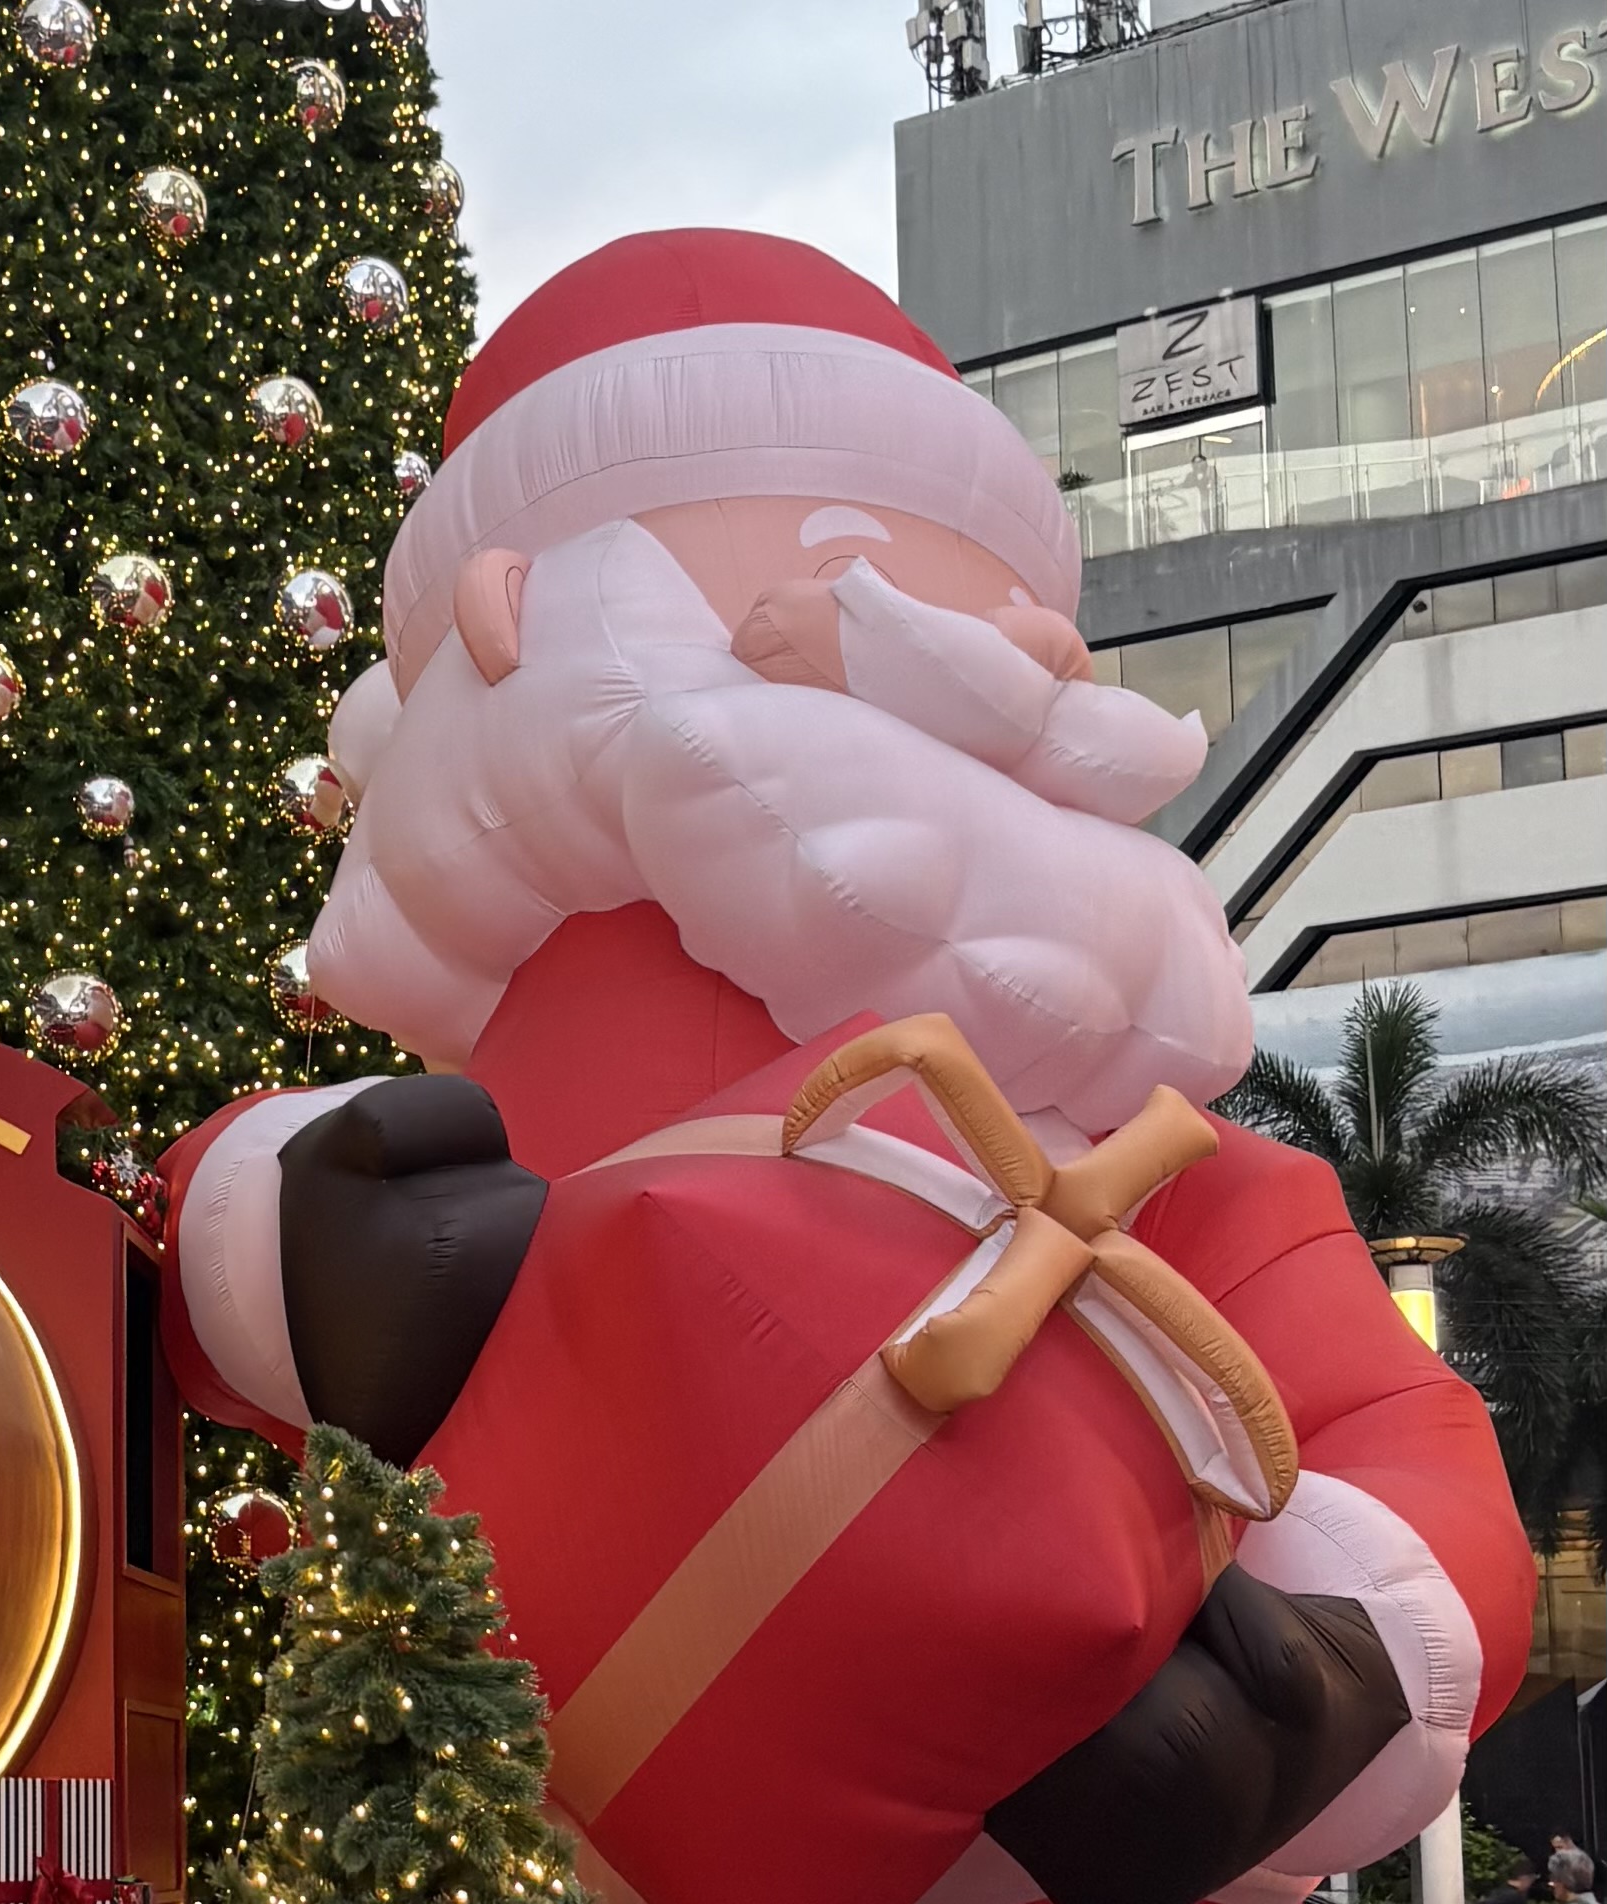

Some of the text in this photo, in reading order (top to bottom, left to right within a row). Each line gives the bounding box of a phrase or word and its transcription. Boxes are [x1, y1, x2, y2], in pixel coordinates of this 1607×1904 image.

[1112, 20, 1607, 227] THE WES
[1161, 309, 1210, 361] Z
[1131, 354, 1245, 403] ZEST
